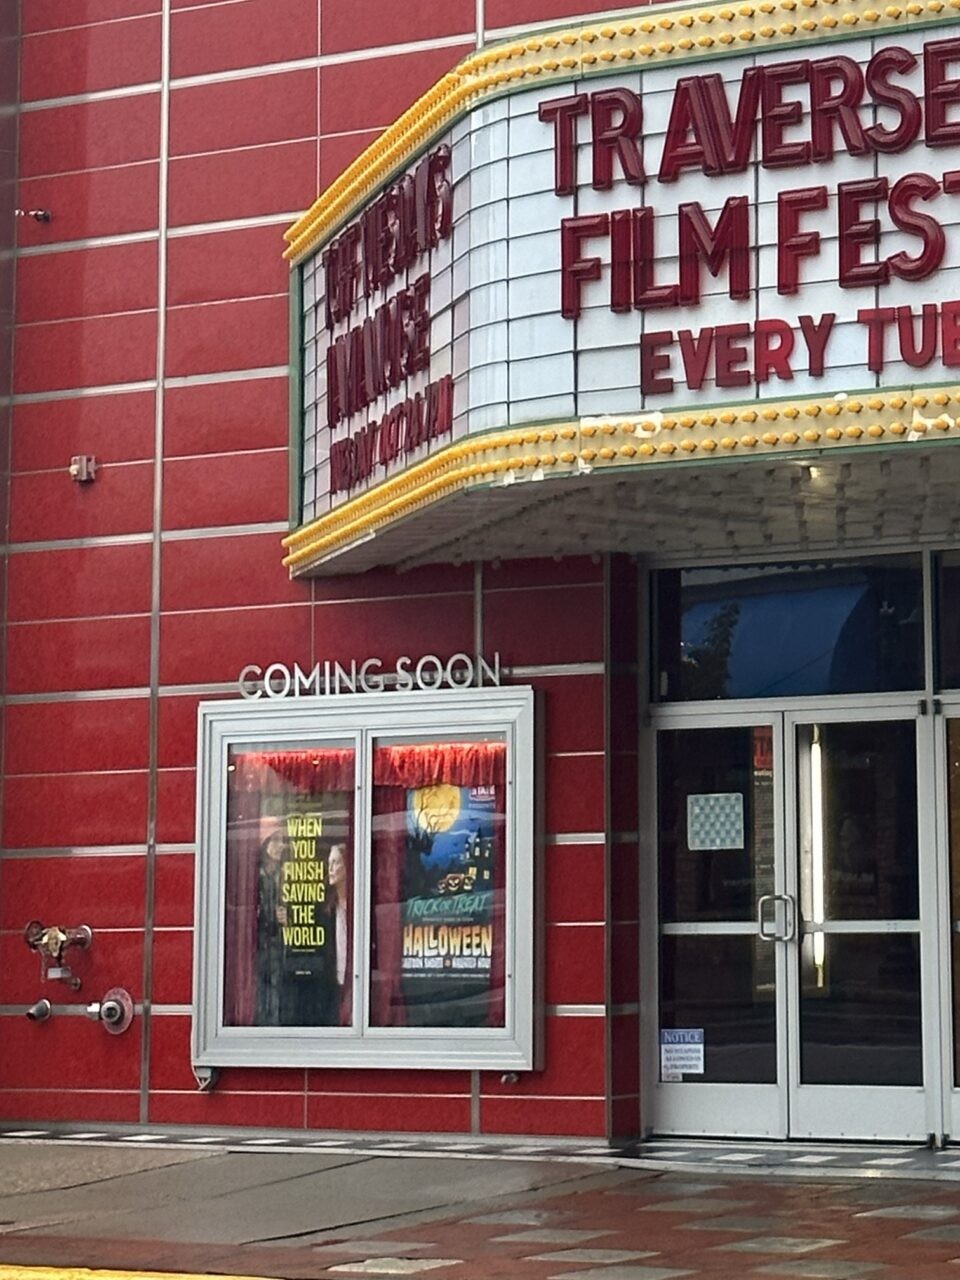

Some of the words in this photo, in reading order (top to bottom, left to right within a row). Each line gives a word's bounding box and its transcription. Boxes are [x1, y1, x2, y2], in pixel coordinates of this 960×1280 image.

[561, 195, 750, 319] FILM
[641, 313, 836, 395] EVERY
[238, 657, 385, 700] COMING
[395, 651, 501, 691] SOON
[287, 817, 323, 837] WHEN
[292, 840, 316, 858] YOU
[283, 861, 324, 881] FINISH
[282, 883, 326, 903] SAVING
[407, 896, 440, 917] TRICK
[451, 891, 493, 914] TREAT
[291, 905, 315, 924] THE
[282, 926, 325, 946] WORLD
[403, 923, 492, 957] HALLOWEEN
[664, 1031, 701, 1043] NOTICE
